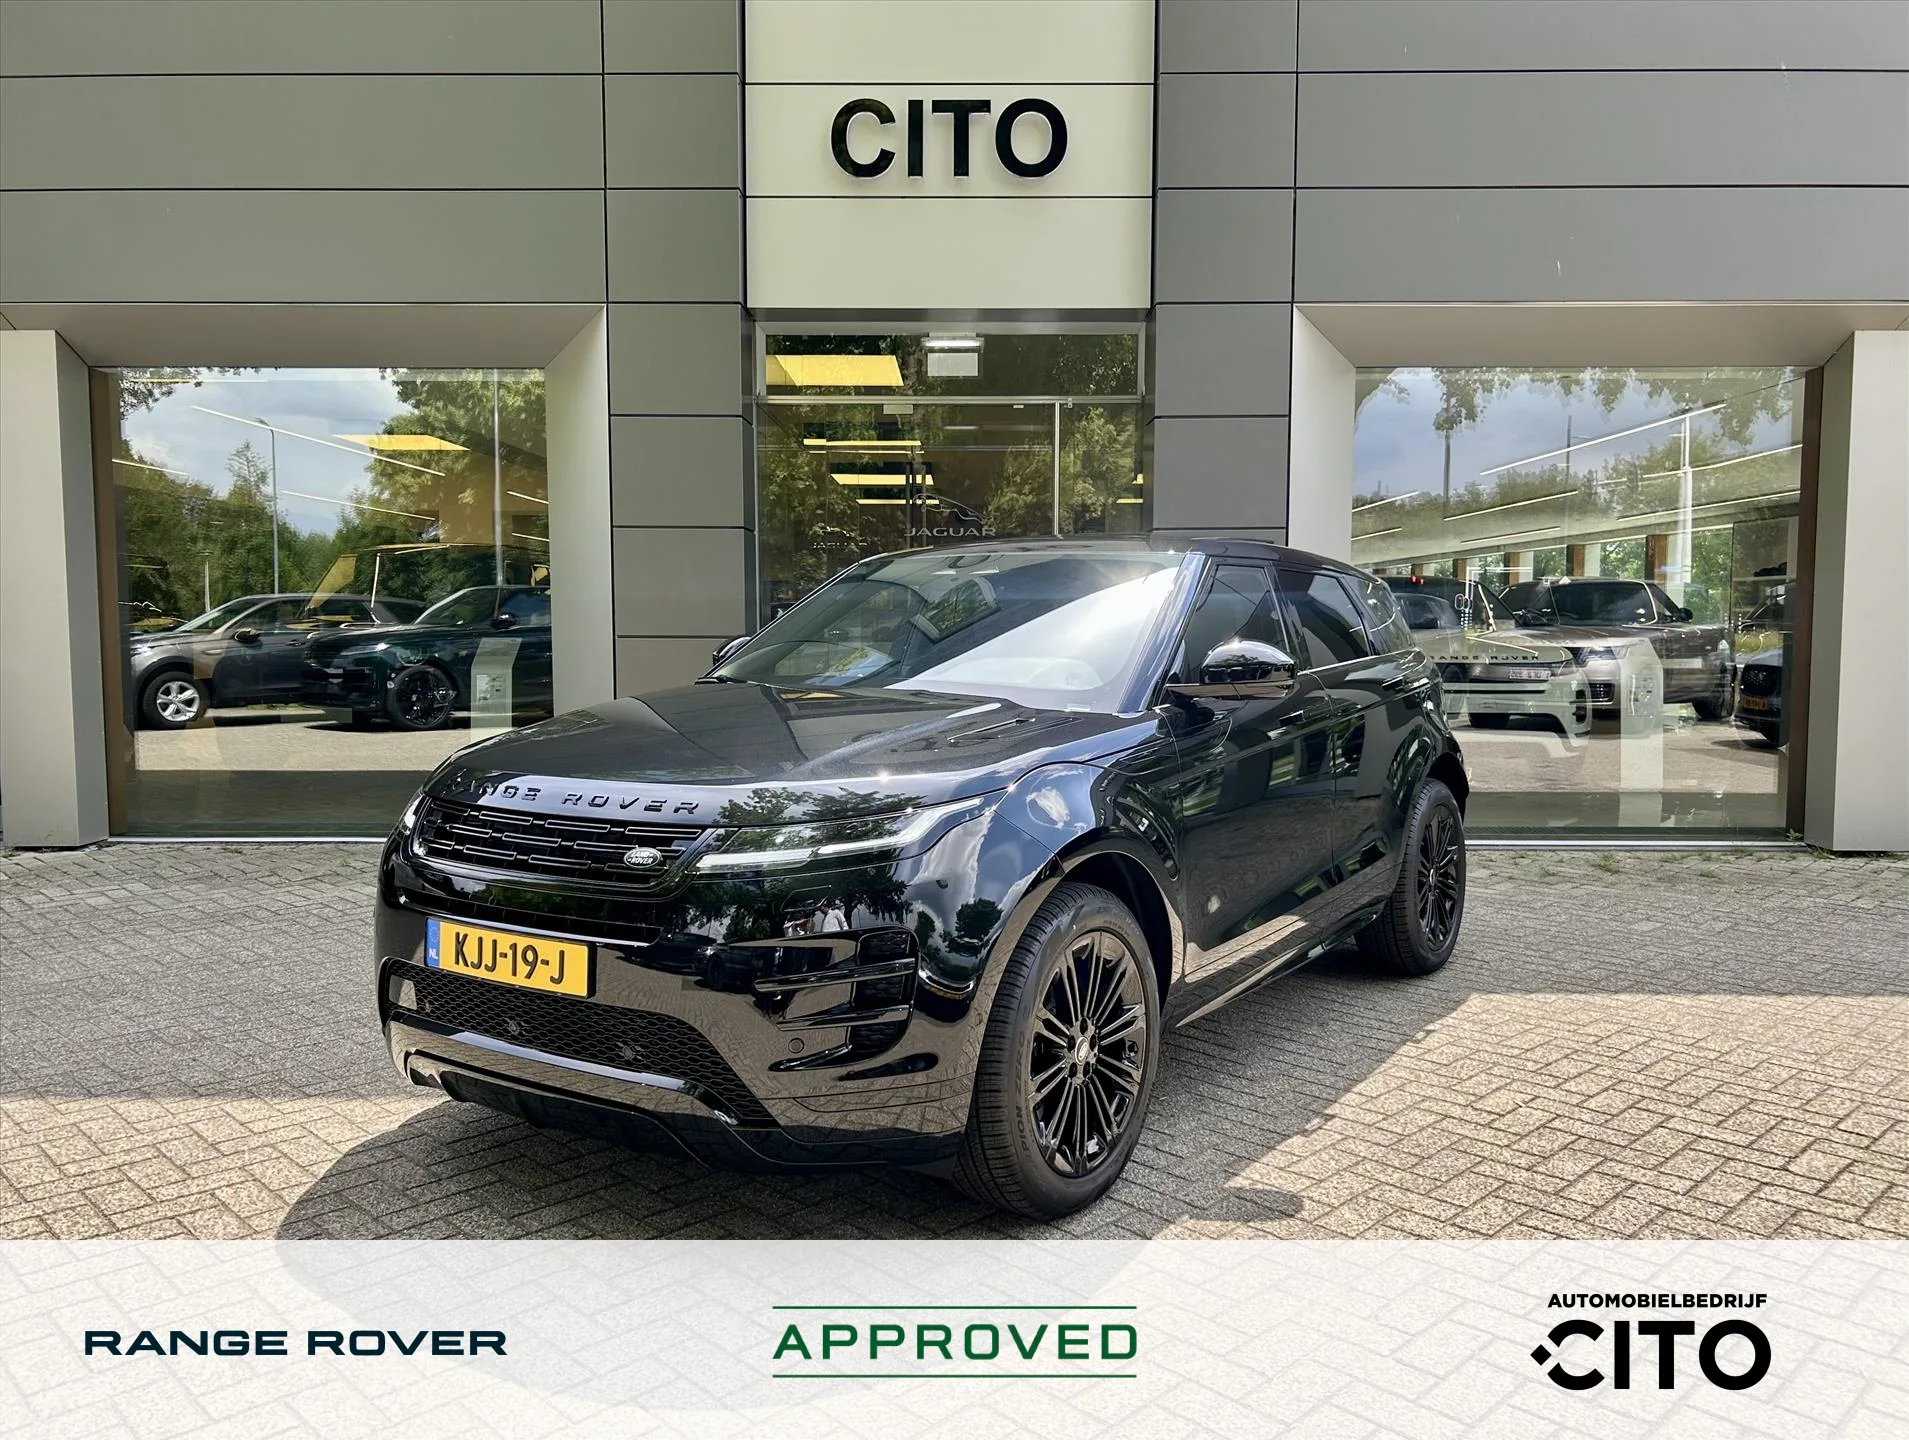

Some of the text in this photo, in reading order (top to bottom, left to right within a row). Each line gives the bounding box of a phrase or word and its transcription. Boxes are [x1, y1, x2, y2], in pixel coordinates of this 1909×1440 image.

[831, 97, 1068, 178] CITO
[903, 527, 996, 537] JAGUAR
[561, 792, 700, 816] ROVER
[631, 857, 654, 865] ROVER
[428, 947, 439, 960] NL
[454, 931, 565, 985] KJJ-19-J
